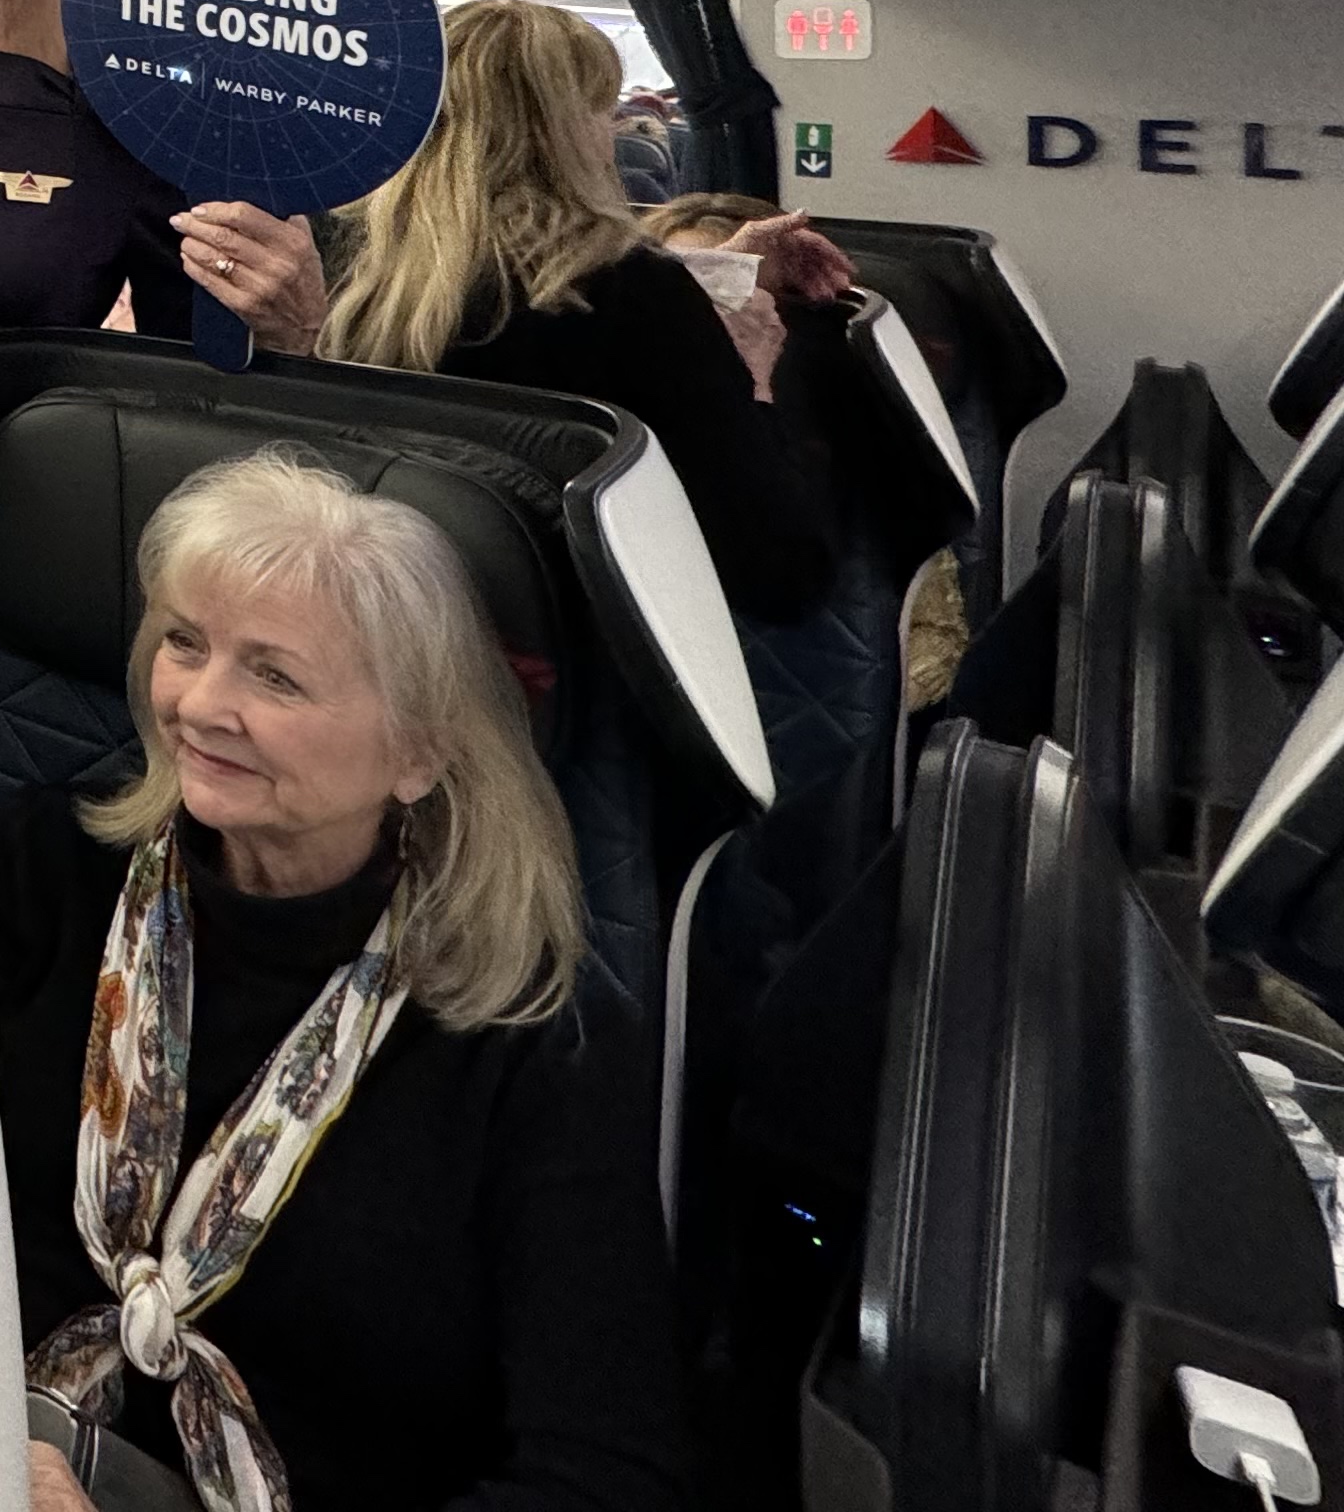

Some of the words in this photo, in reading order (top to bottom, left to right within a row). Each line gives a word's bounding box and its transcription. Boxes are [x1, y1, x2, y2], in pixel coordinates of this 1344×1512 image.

[195, 3, 370, 68] COSMOS
[125, 56, 193, 85] DELTA
[215, 77, 287, 106] WARBY
[296, 95, 383, 127] PARKER
